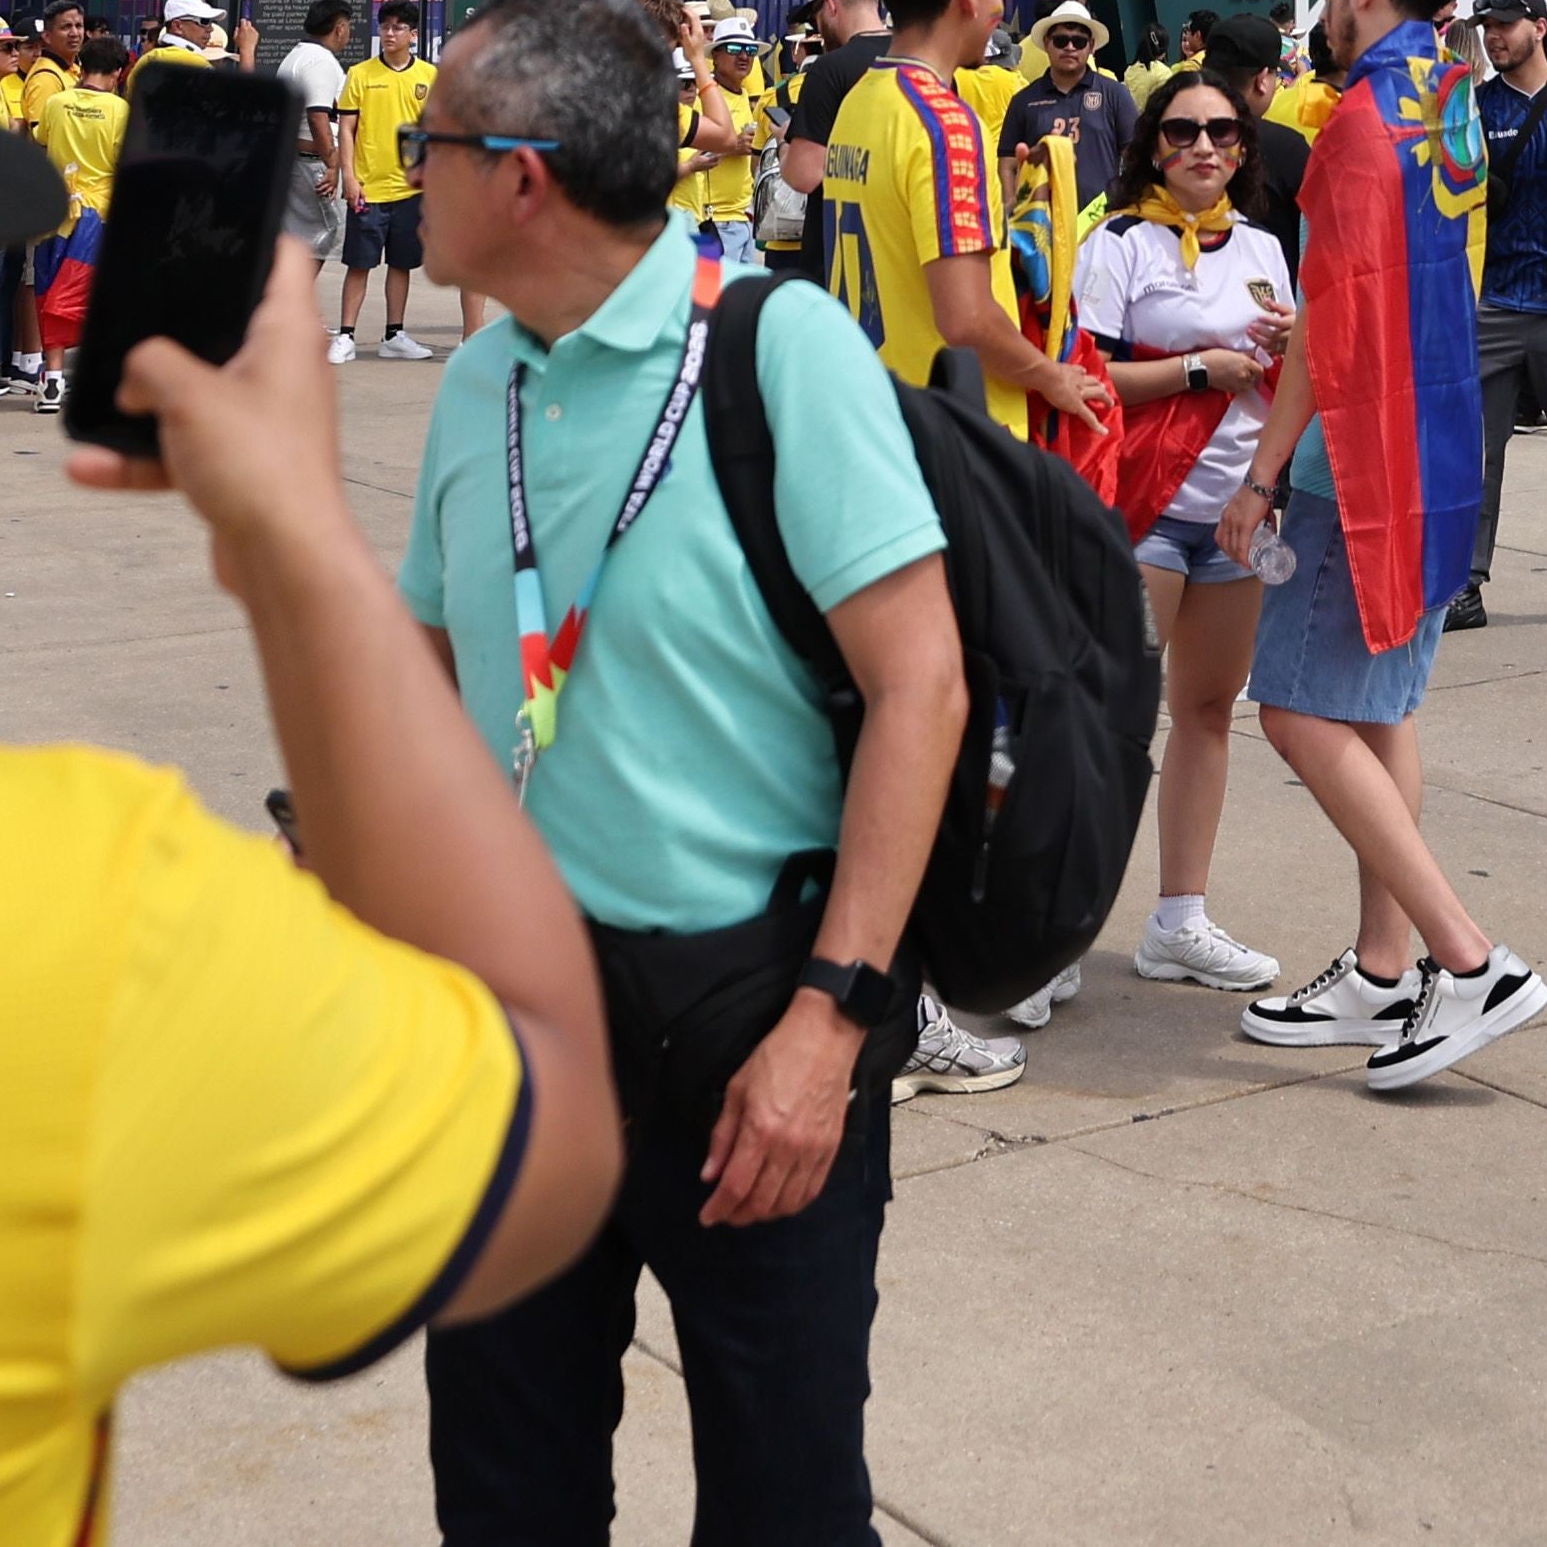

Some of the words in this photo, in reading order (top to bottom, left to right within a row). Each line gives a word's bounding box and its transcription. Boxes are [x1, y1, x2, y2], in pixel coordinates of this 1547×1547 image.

[618, 490, 647, 533] FIFA
[635, 420, 677, 493] WORLD
[665, 381, 691, 423] CUP
[680, 320, 709, 386] 2026
[509, 447, 521, 484] CUP
[510, 484, 530, 552] 2026
